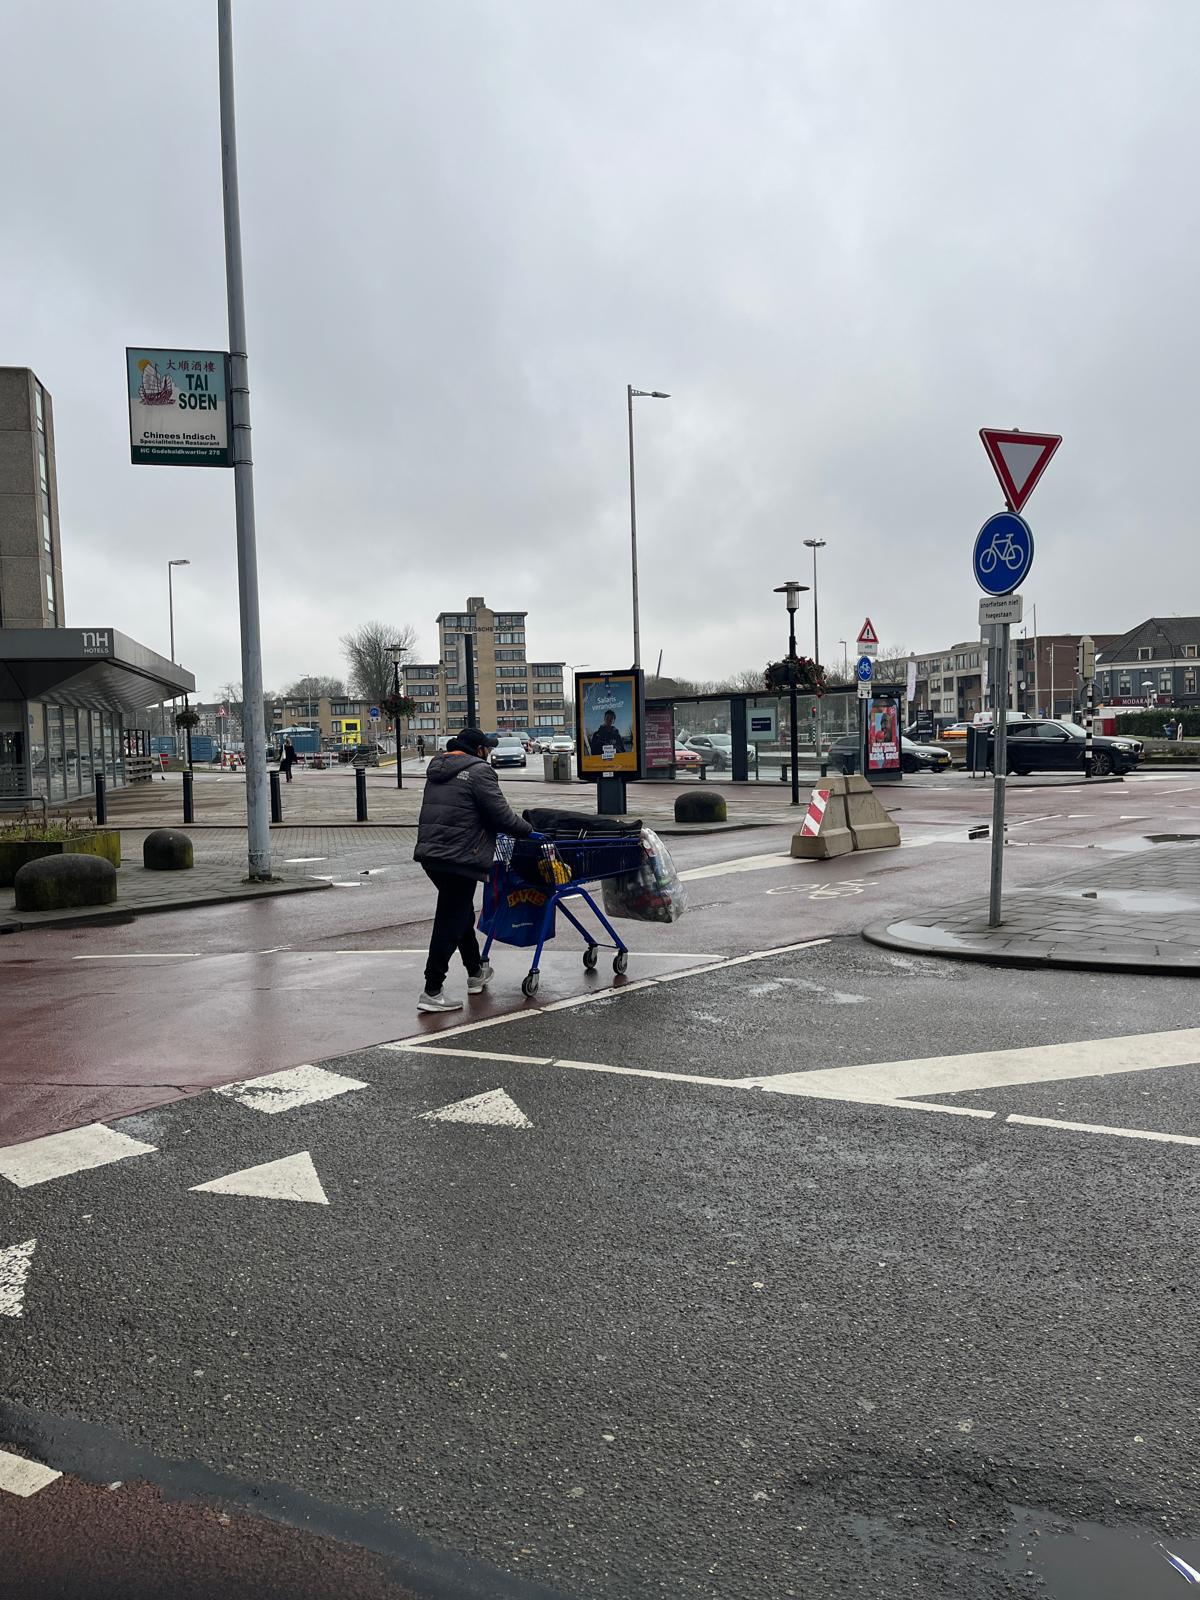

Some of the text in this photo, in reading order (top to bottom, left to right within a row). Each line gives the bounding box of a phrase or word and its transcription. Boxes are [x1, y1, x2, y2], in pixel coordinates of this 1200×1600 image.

[166, 359, 216, 373] 大順酒樓
[186, 374, 208, 391] TAI
[178, 393, 217, 411] SOEN
[143, 432, 216, 441] Chinees Indisch
[985, 611, 1012, 620] toegestaan
